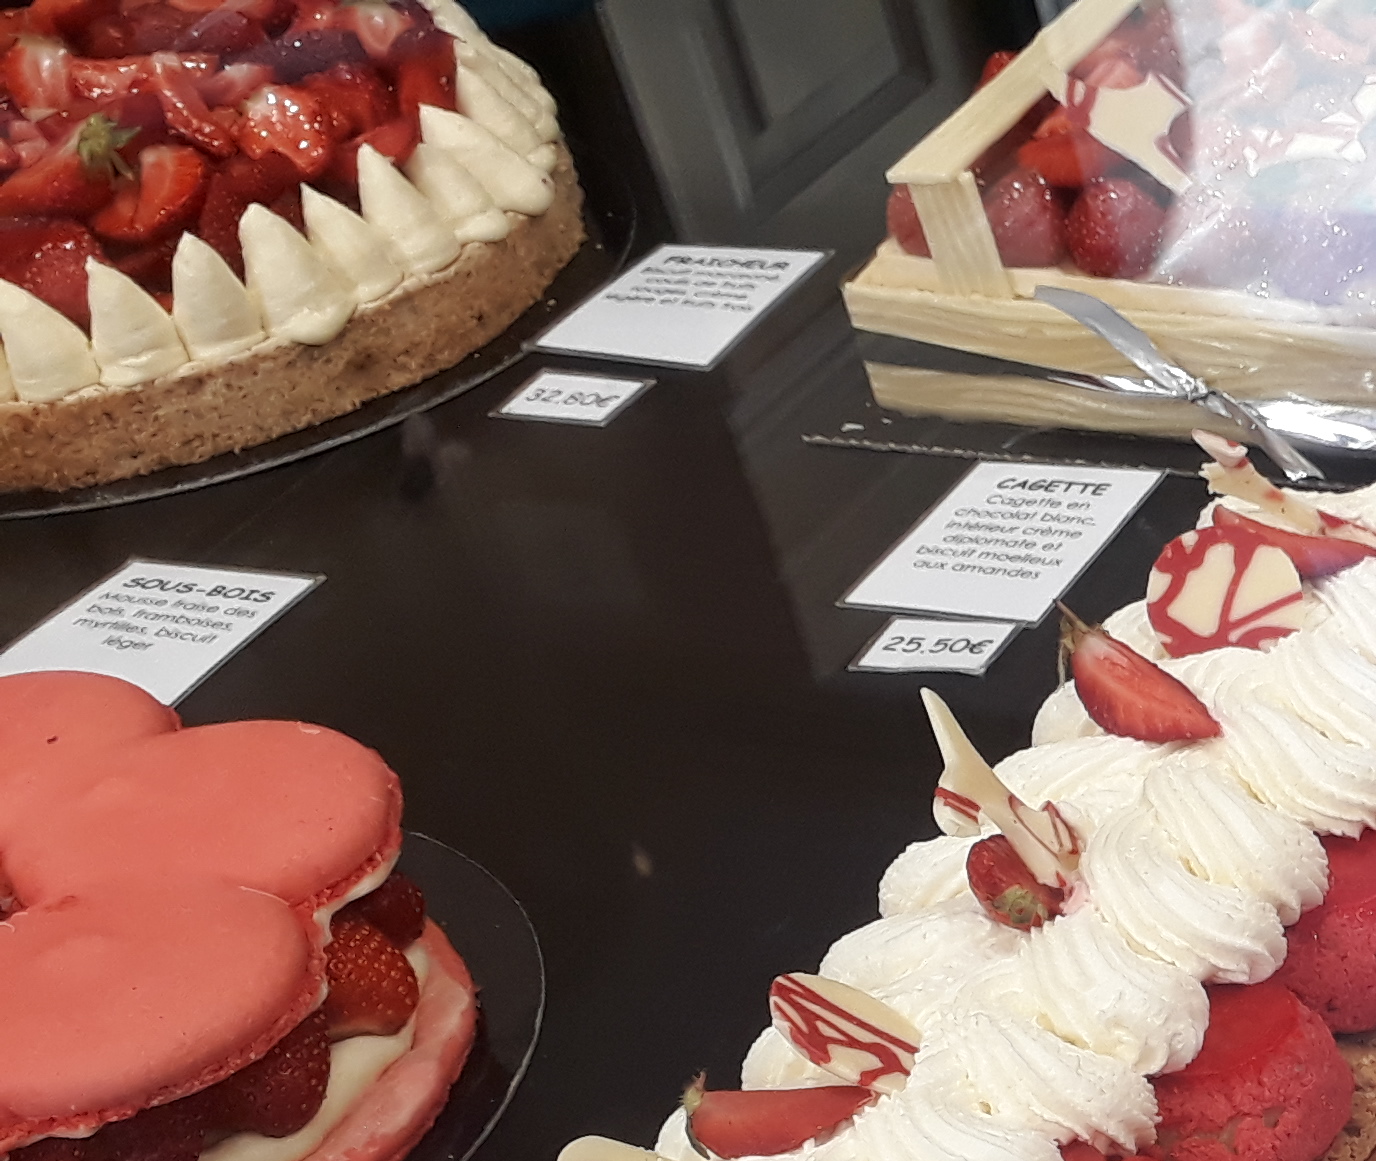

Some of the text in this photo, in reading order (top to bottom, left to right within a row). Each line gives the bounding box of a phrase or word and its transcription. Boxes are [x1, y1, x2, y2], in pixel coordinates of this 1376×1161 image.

[996, 477, 1112, 496] CAGETTE
[985, 494, 1091, 510] Cagette en
[953, 507, 1038, 521] chocolat
[1021, 525, 1083, 539] crème
[942, 535, 1063, 551] diplomate et
[915, 544, 1064, 567] biscuit moelleux
[912, 559, 1041, 580] aux amandes
[122, 576, 276, 603] SOUS-BOIS
[223, 605, 258, 619] des
[100, 634, 155, 652] léger
[154, 625, 219, 644] biscuit
[881, 635, 996, 656] 25.50€
